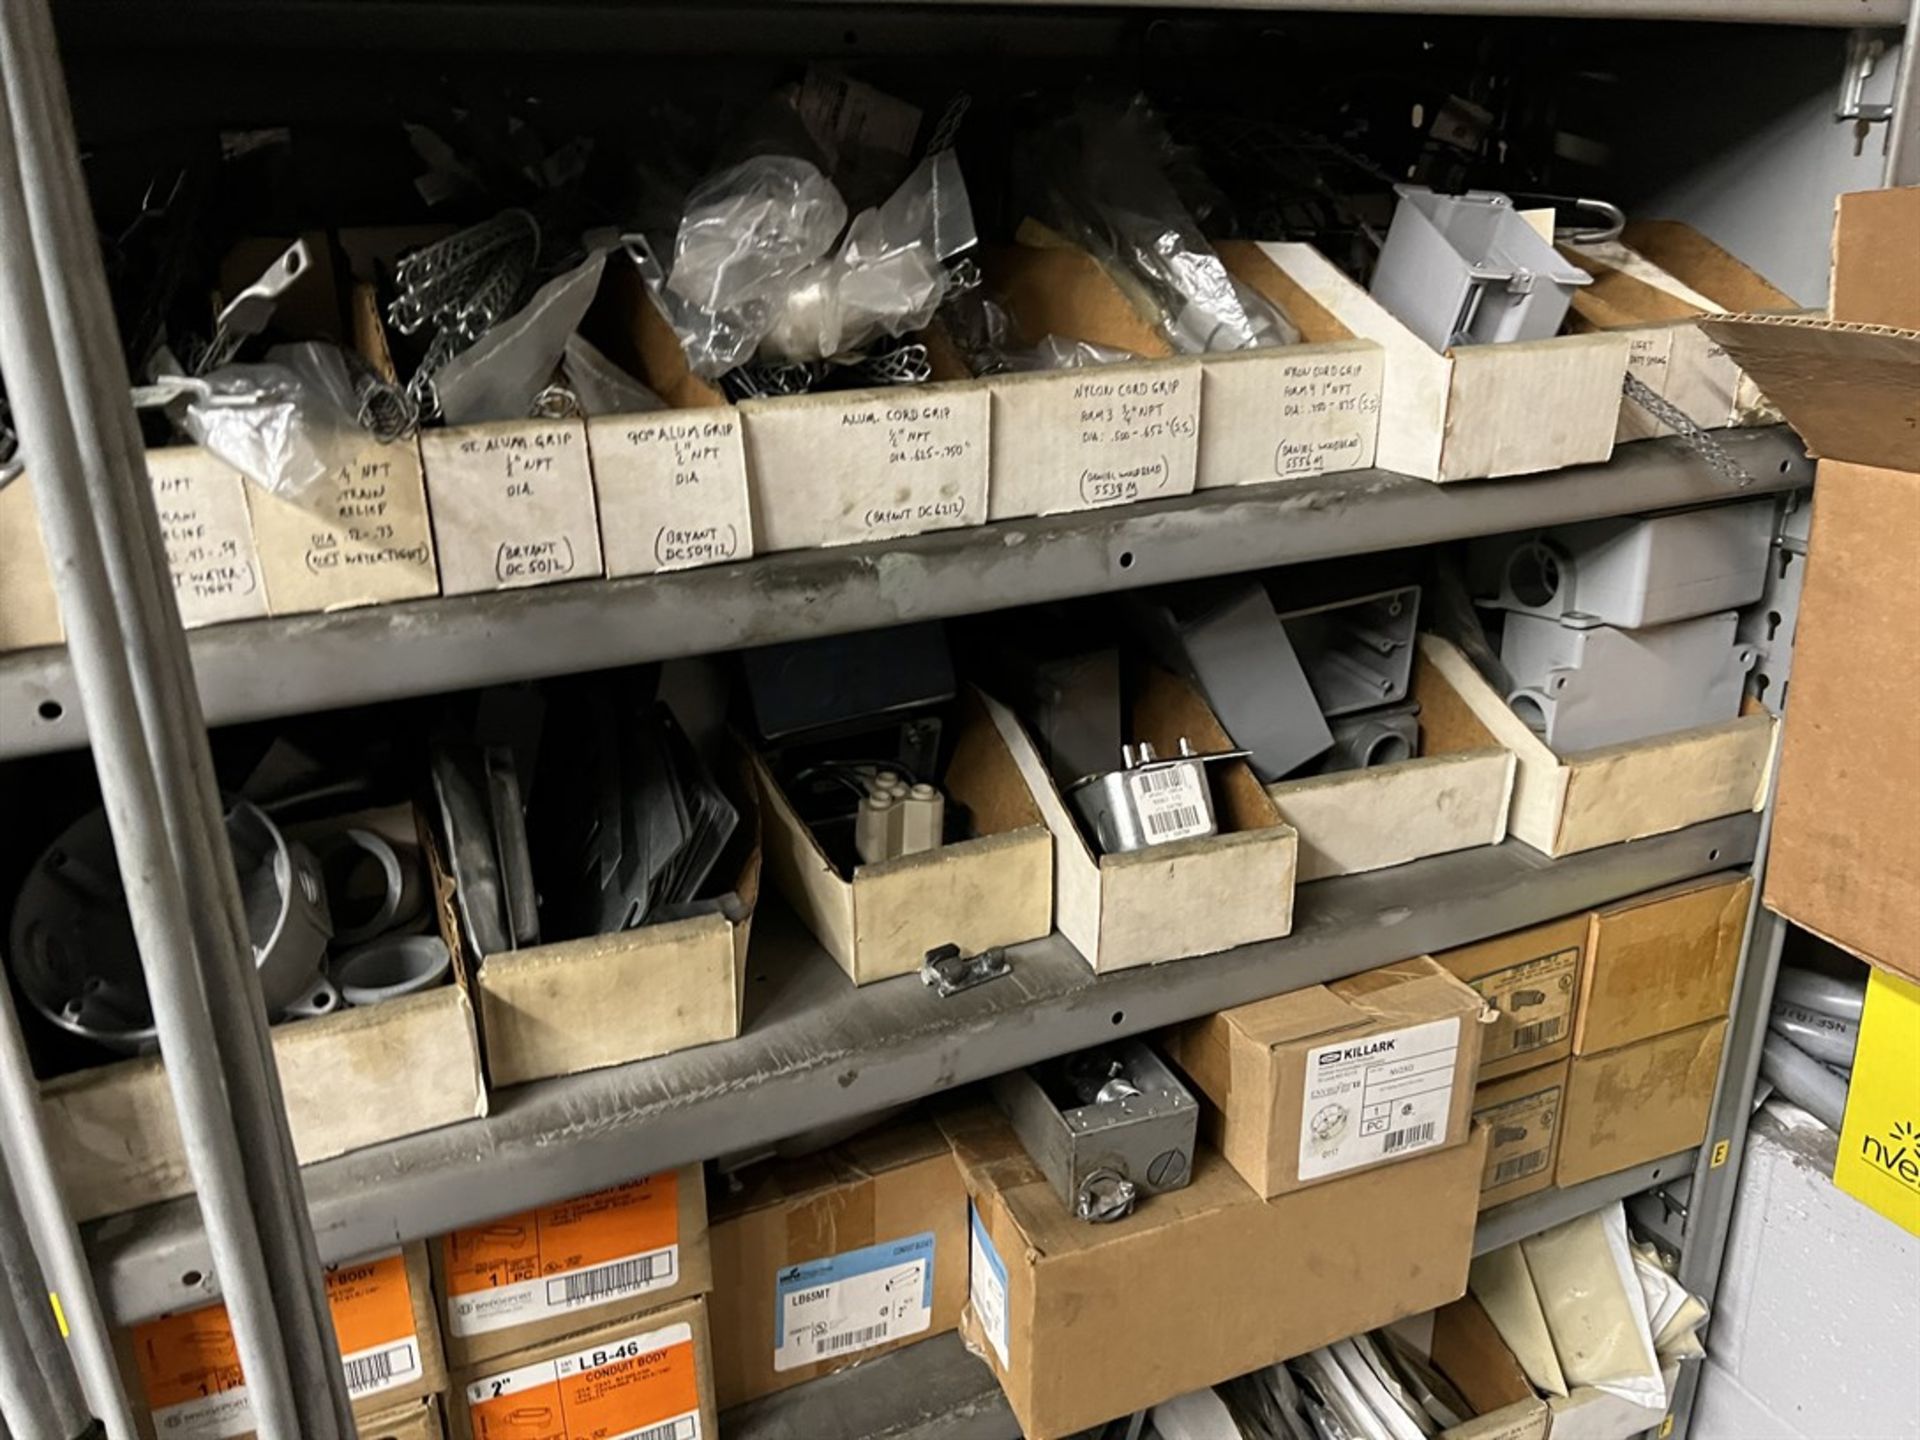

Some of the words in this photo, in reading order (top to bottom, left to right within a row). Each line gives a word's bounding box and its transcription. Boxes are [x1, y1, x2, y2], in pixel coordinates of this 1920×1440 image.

[1073, 383, 1115, 399] NYLON
[1117, 382, 1148, 397] CORD
[1151, 379, 1180, 396] GRIP
[885, 409, 918, 422] CORD
[922, 407, 951, 420] GRIP
[1138, 402, 1165, 417] NPT
[534, 431, 573, 449] GRIP
[657, 425, 700, 441] ALUM
[703, 423, 733, 437] GRIP
[907, 431, 931, 442] NPT
[690, 447, 719, 461] NPT
[361, 463, 390, 479] NPT
[523, 457, 553, 472] NPT
[675, 470, 700, 486] DIA
[1343, 1039, 1396, 1060] KILLARK
[1366, 1120, 1384, 1132] PC
[1713, 1146, 1723, 1163] E
[338, 1267, 376, 1286] BODY
[488, 1273, 498, 1287] 1
[513, 1270, 534, 1282] PC
[579, 1341, 639, 1371] LB-46
[585, 1360, 634, 1382] CONDUIT
[637, 1349, 668, 1367] BODY
[198, 1383, 208, 1396] 1
[491, 1377, 511, 1397] 2"
